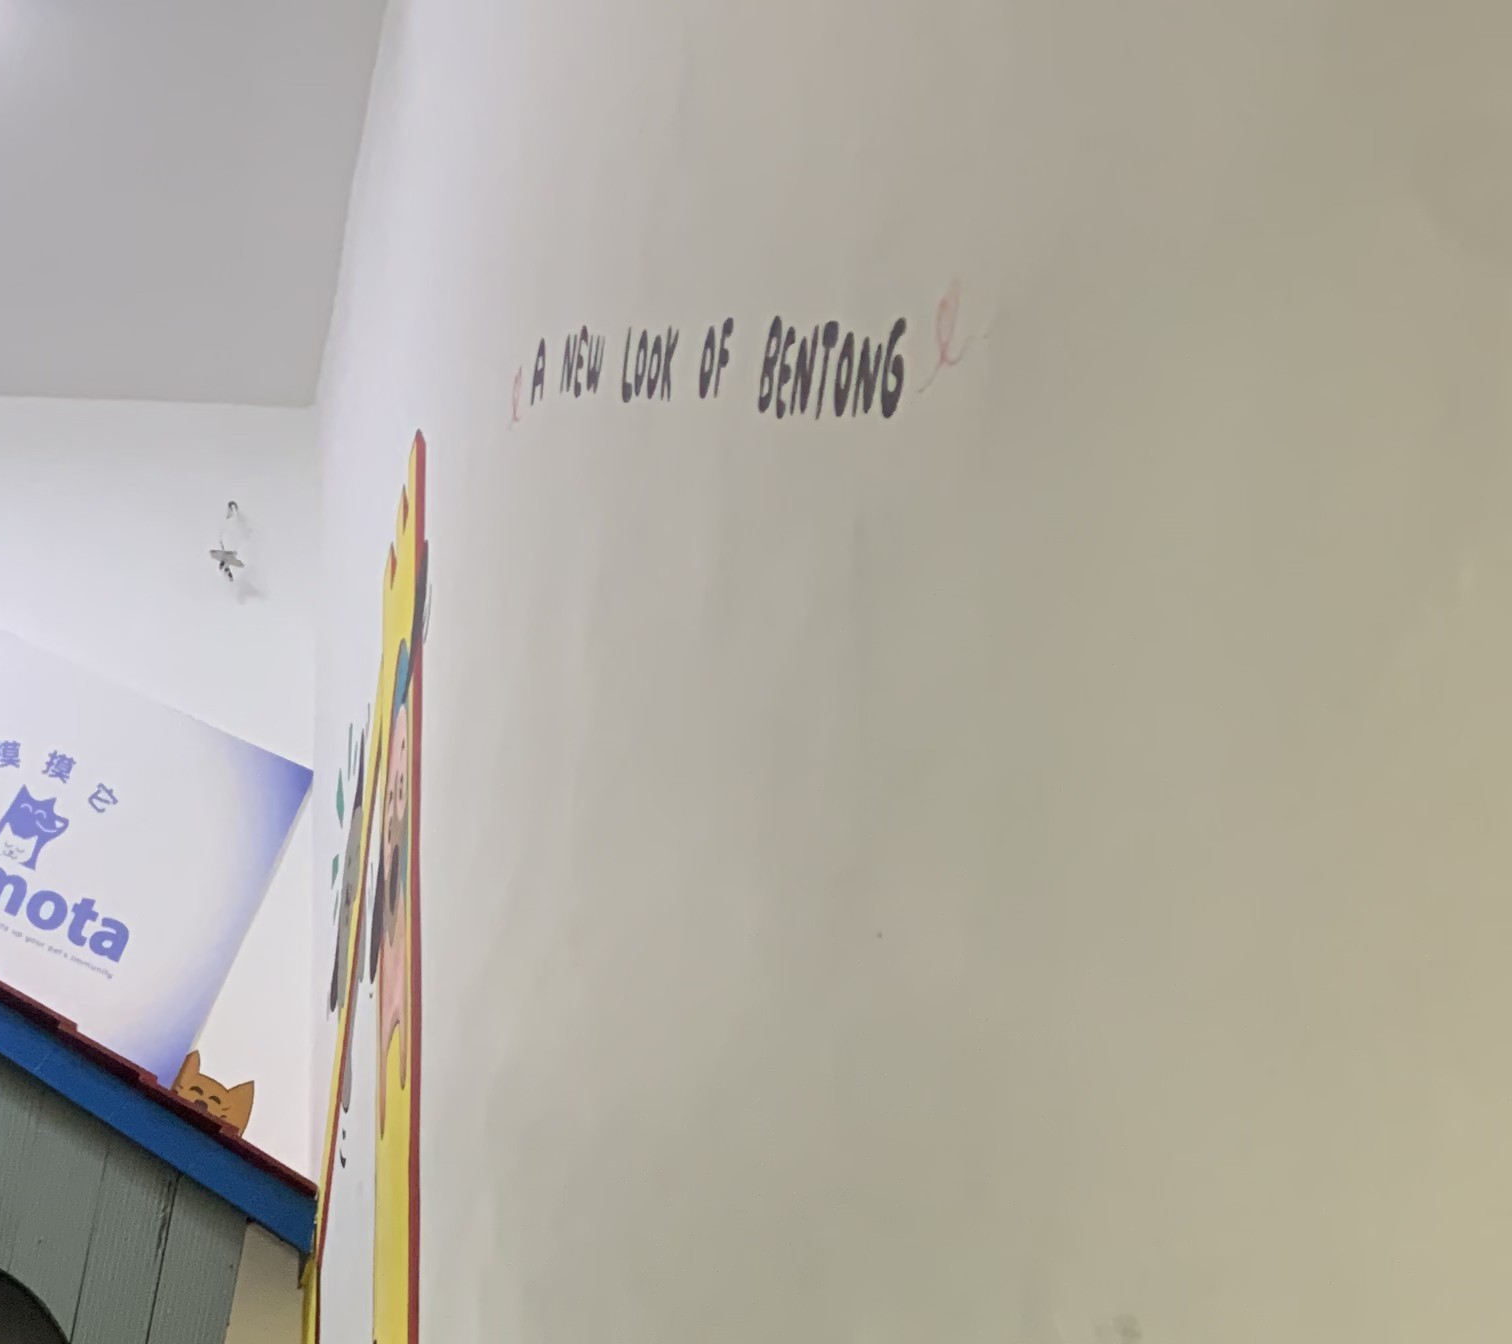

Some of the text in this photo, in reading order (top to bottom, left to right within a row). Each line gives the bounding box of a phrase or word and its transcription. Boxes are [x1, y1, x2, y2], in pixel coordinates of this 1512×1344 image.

[532, 315, 907, 420] A NEW LOOK OF BENTONG
